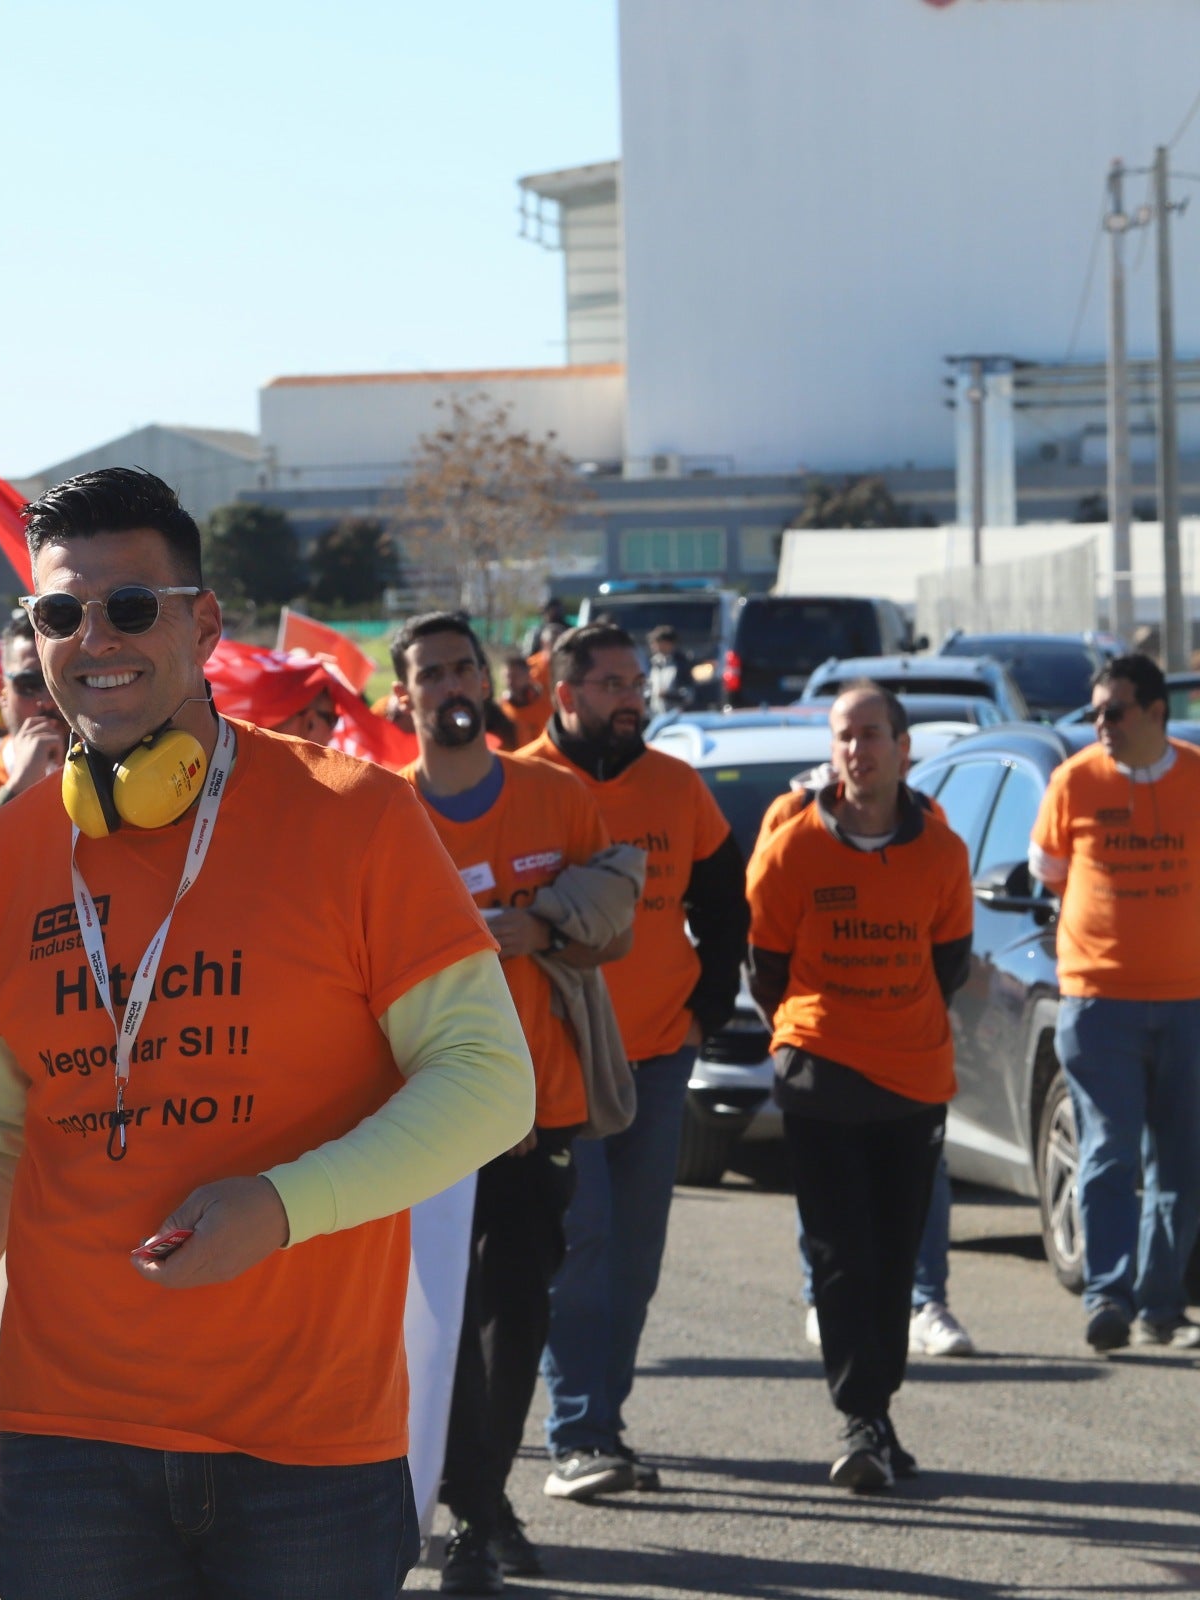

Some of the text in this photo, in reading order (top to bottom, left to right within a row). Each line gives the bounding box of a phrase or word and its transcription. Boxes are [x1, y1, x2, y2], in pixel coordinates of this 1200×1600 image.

[1103, 832, 1185, 851] Hitachi
[832, 919, 918, 940] Hitachi
[124, 1001, 138, 1034] HITACHI
[178, 1025, 214, 1056] SI
[228, 1025, 249, 1055] !!
[161, 1096, 219, 1127] NO
[231, 1094, 255, 1124] !!
